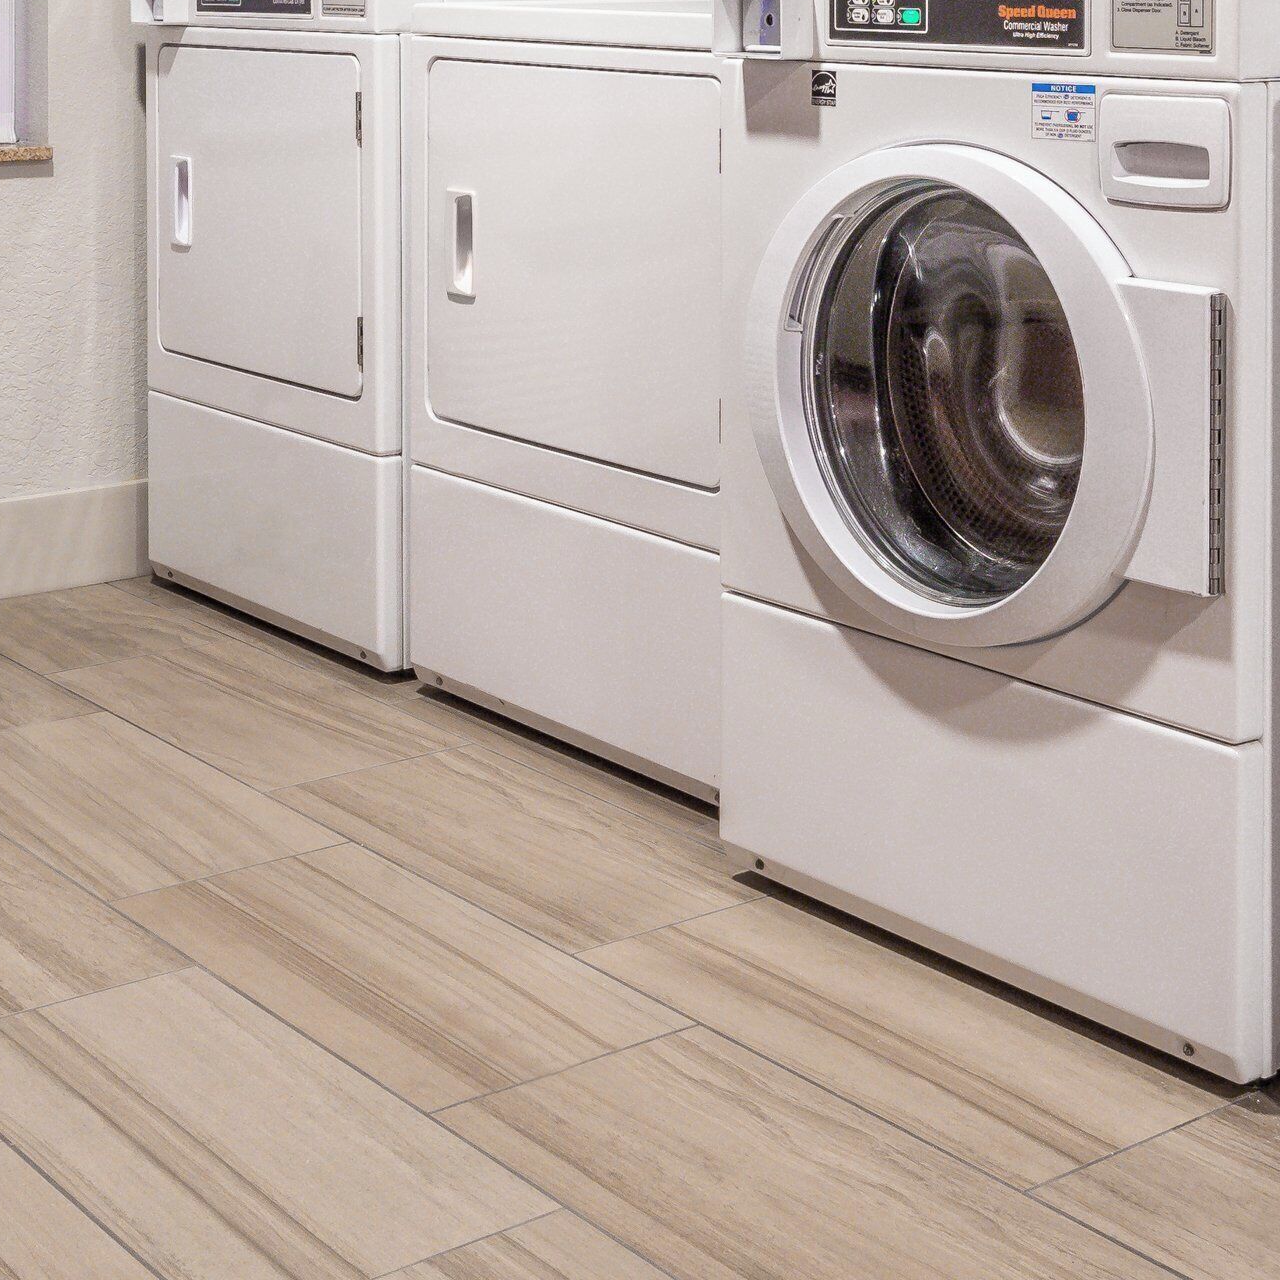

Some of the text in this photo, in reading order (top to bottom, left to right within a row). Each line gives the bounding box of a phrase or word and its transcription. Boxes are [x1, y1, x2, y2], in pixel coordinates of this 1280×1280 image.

[998, 4, 1076, 20] Speed Queen
[1003, 20, 1068, 31] Commercial Washer
[1036, 32, 1059, 40] Efficiency
